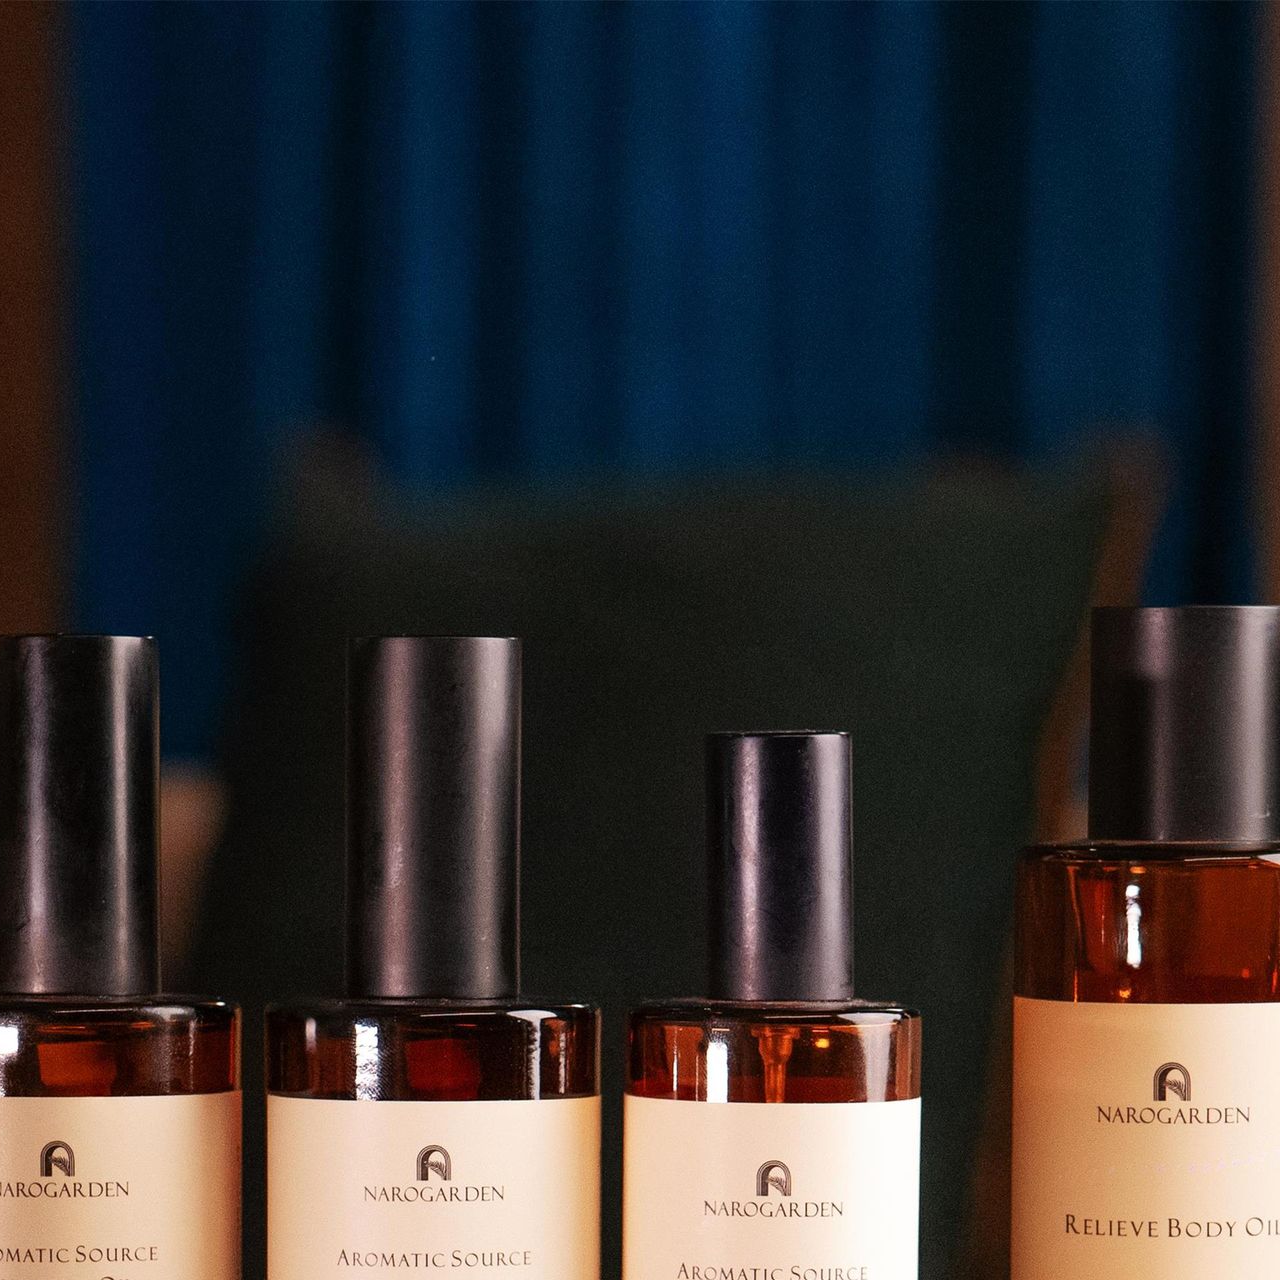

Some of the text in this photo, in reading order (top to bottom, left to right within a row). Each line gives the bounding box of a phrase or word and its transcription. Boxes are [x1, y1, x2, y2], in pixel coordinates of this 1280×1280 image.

[1097, 1105, 1250, 1125] NAROGARDEN
[363, 1185, 504, 1203] NAROGARDEN
[703, 1200, 843, 1218] NAROGARDEN
